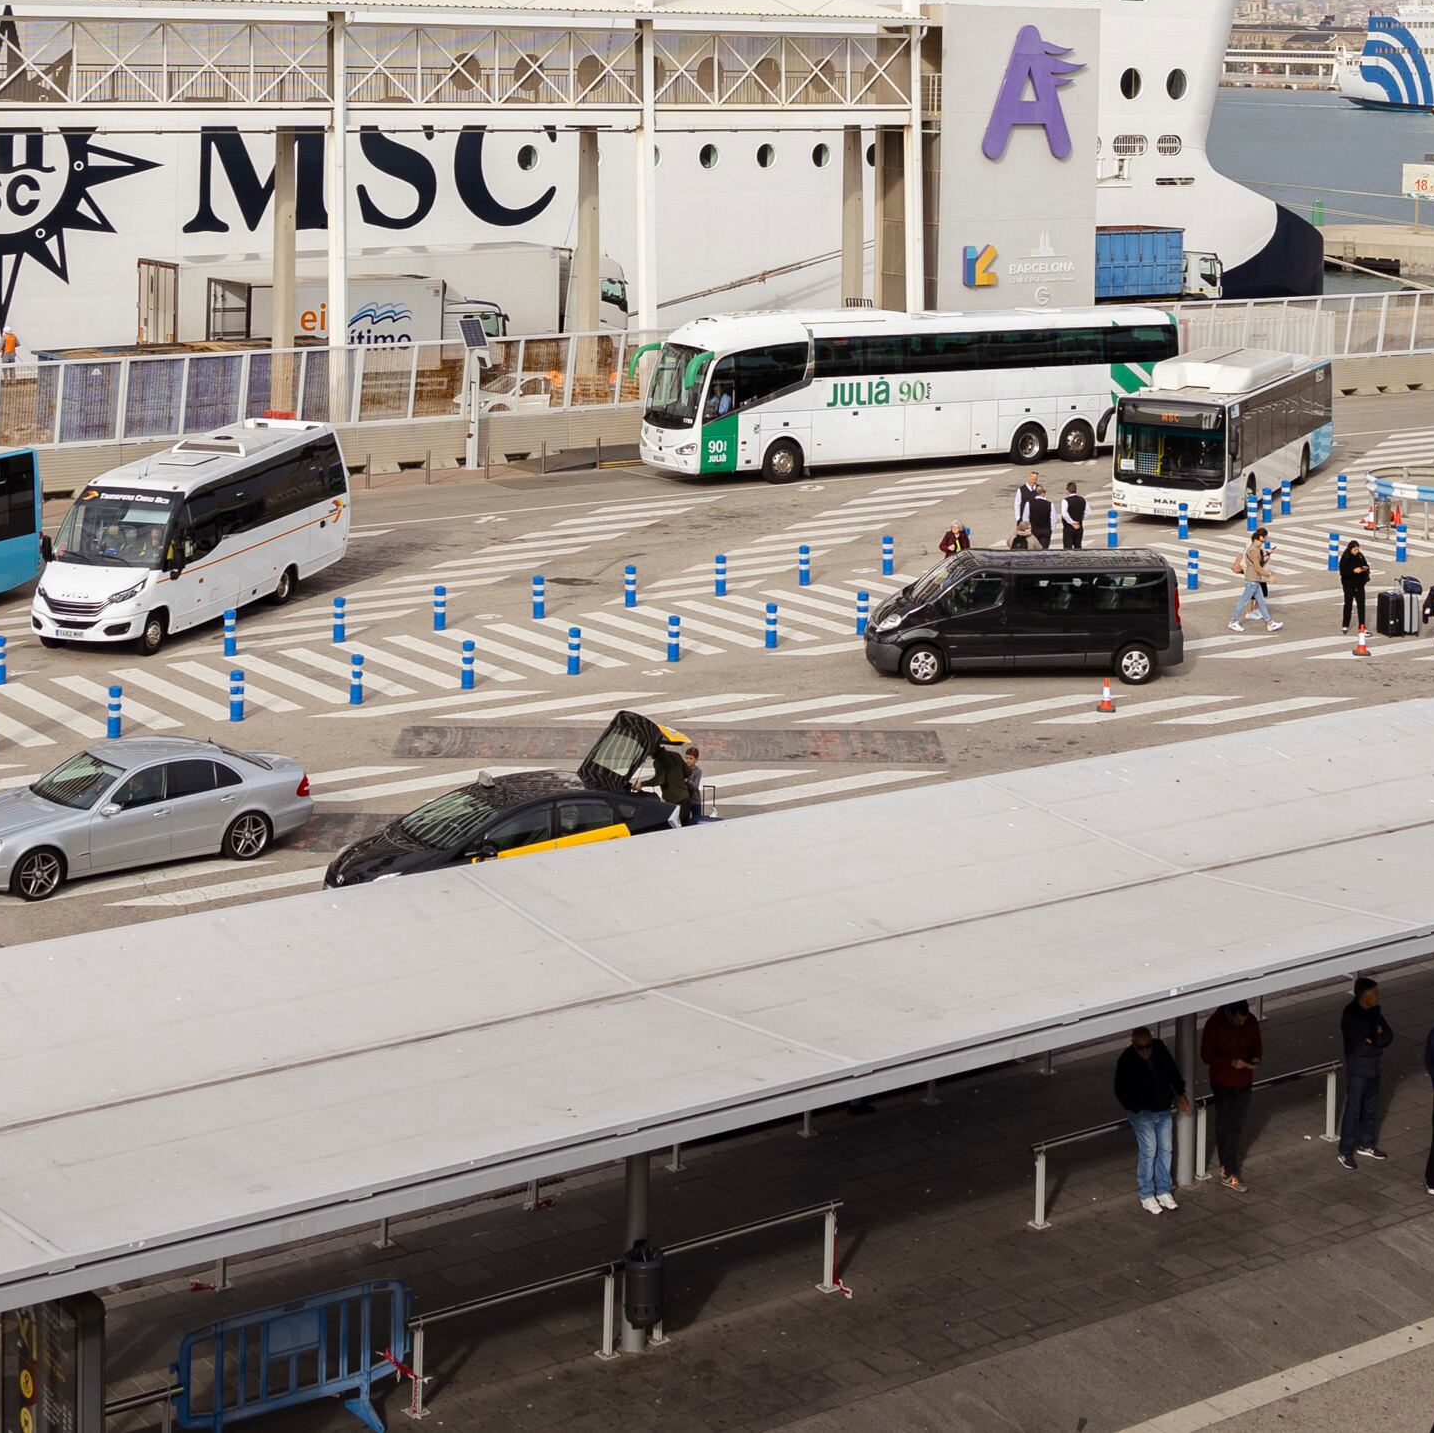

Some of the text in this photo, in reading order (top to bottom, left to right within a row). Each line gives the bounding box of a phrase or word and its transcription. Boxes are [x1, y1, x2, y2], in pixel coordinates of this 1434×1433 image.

[181, 97, 558, 234] MSC
[1414, 178, 1428, 191] 18
[1008, 261, 1076, 275] BARCELONA
[898, 379, 926, 404] 90
[1161, 413, 1180, 423] MSC
[708, 439, 724, 455] 90
